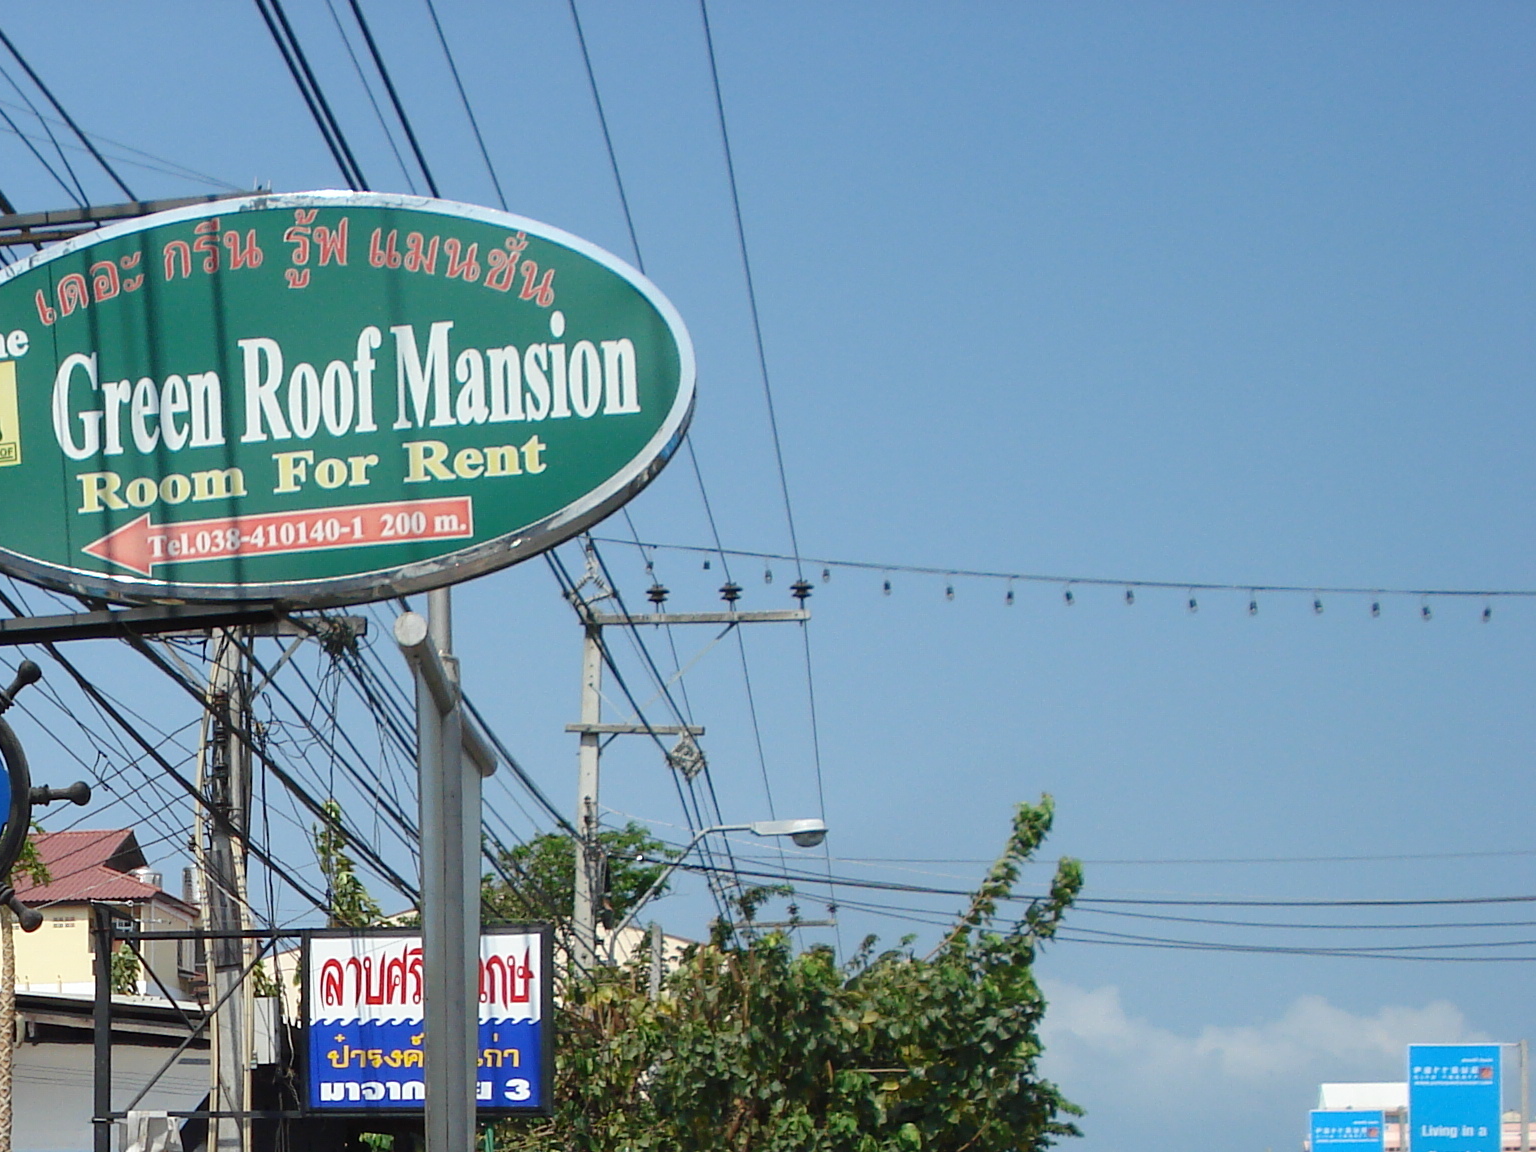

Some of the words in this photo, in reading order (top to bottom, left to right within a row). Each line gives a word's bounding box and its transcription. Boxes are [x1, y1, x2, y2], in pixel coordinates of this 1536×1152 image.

[35, 252, 144, 327] เดอะ
[164, 219, 263, 281] กรีน
[282, 208, 348, 290] รู้ฟ
[370, 227, 555, 309] แมนชั่น
[51, 352, 226, 462] Green
[238, 324, 381, 445] Roof
[391, 312, 641, 431] Mansion
[76, 464, 247, 516] Room
[273, 448, 379, 495] For
[402, 435, 548, 483] Rent
[146, 515, 365, 562] Tel.038-410140-1
[381, 508, 425, 537] 200
[433, 511, 468, 535] m.
[504, 1078, 531, 1101] 3
[1421, 1125, 1458, 1139] Living
[1461, 1125, 1474, 1137] in
[1477, 1126, 1488, 1137] a
